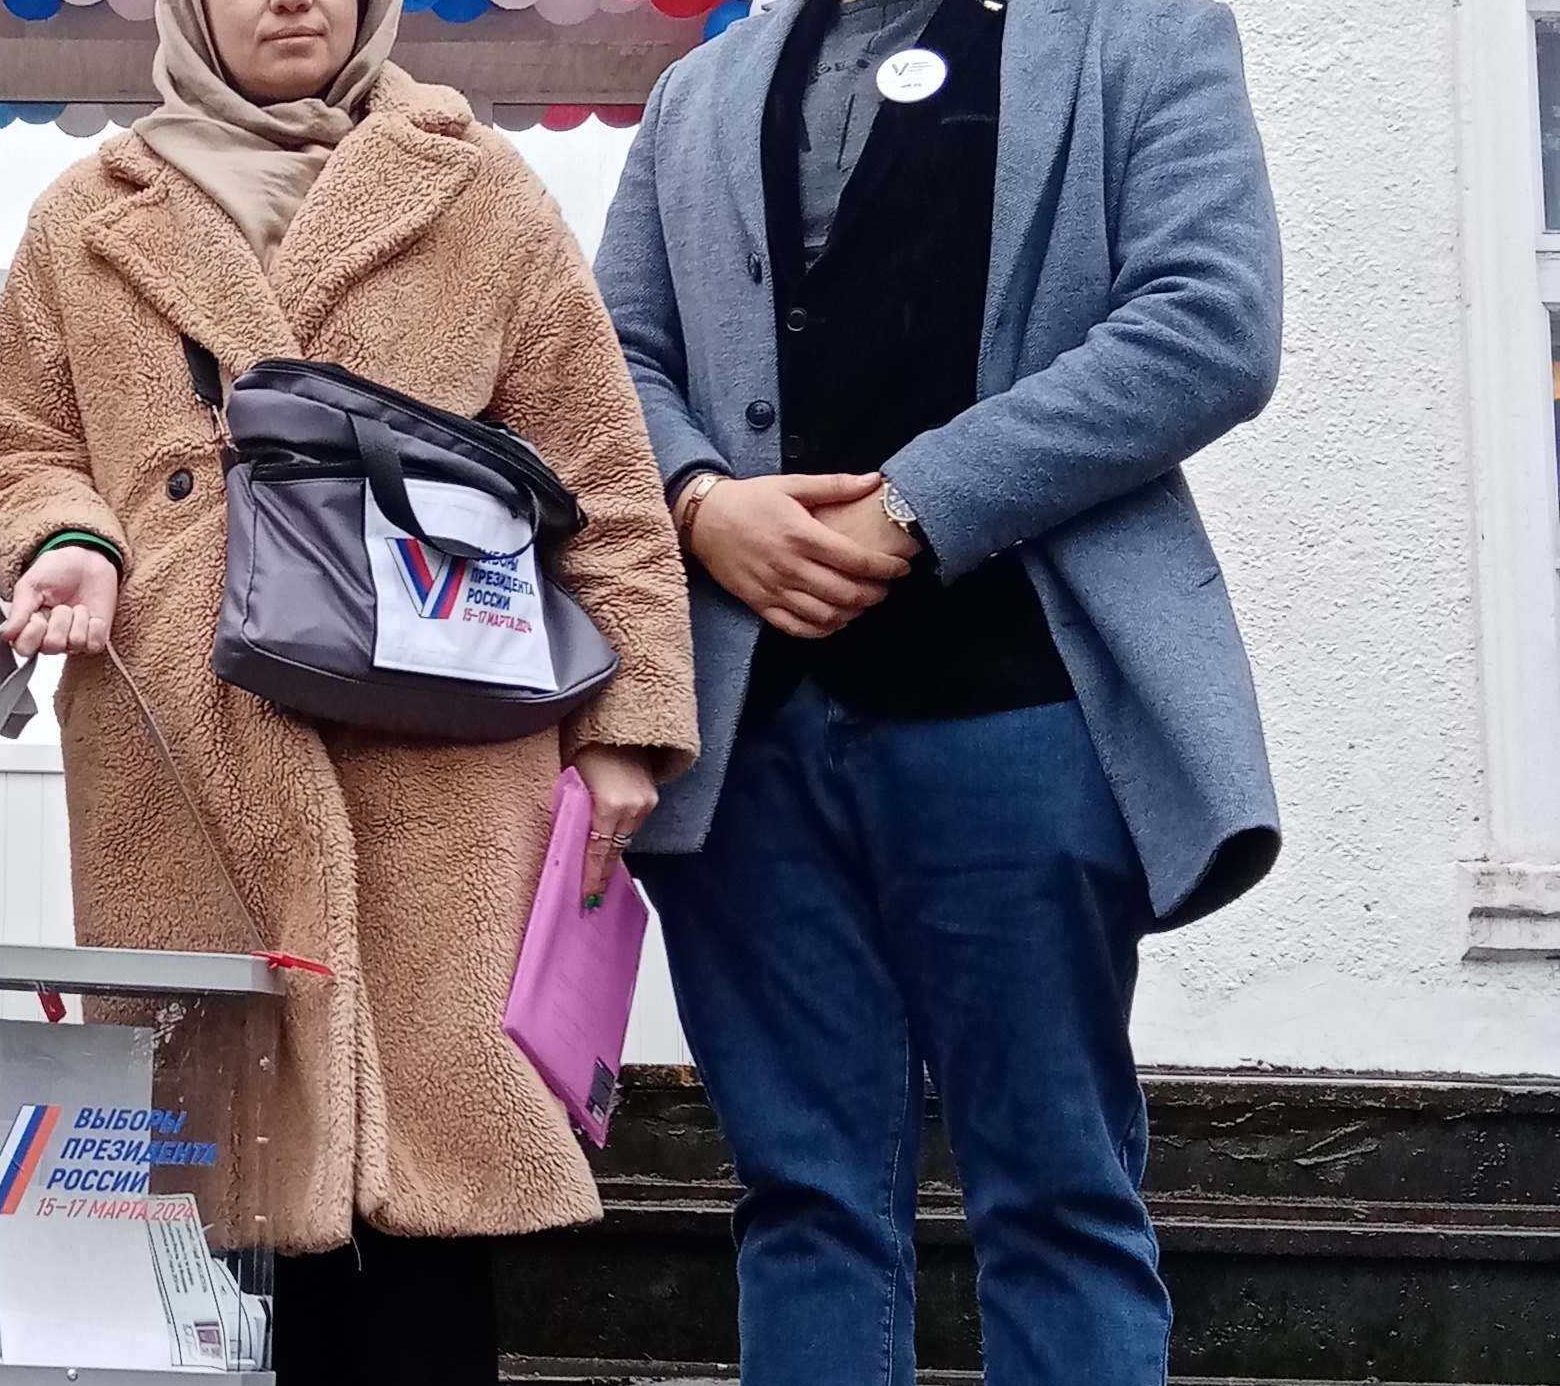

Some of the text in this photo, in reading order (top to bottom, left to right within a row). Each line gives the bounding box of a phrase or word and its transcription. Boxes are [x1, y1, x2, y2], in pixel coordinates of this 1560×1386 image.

[470, 567, 535, 597] ПРЕЗИДЕНТА
[466, 588, 511, 611] РОССИИ
[462, 607, 488, 625] 15–17
[486, 612, 515, 630] МАРТА
[74, 1107, 187, 1136] ВЫБОРЫ
[59, 1138, 218, 1166] ПРЕЗИДЕНТА
[46, 1168, 150, 1194] РОССИИ
[36, 1197, 195, 1223] 15–17 МАРТА 2024
